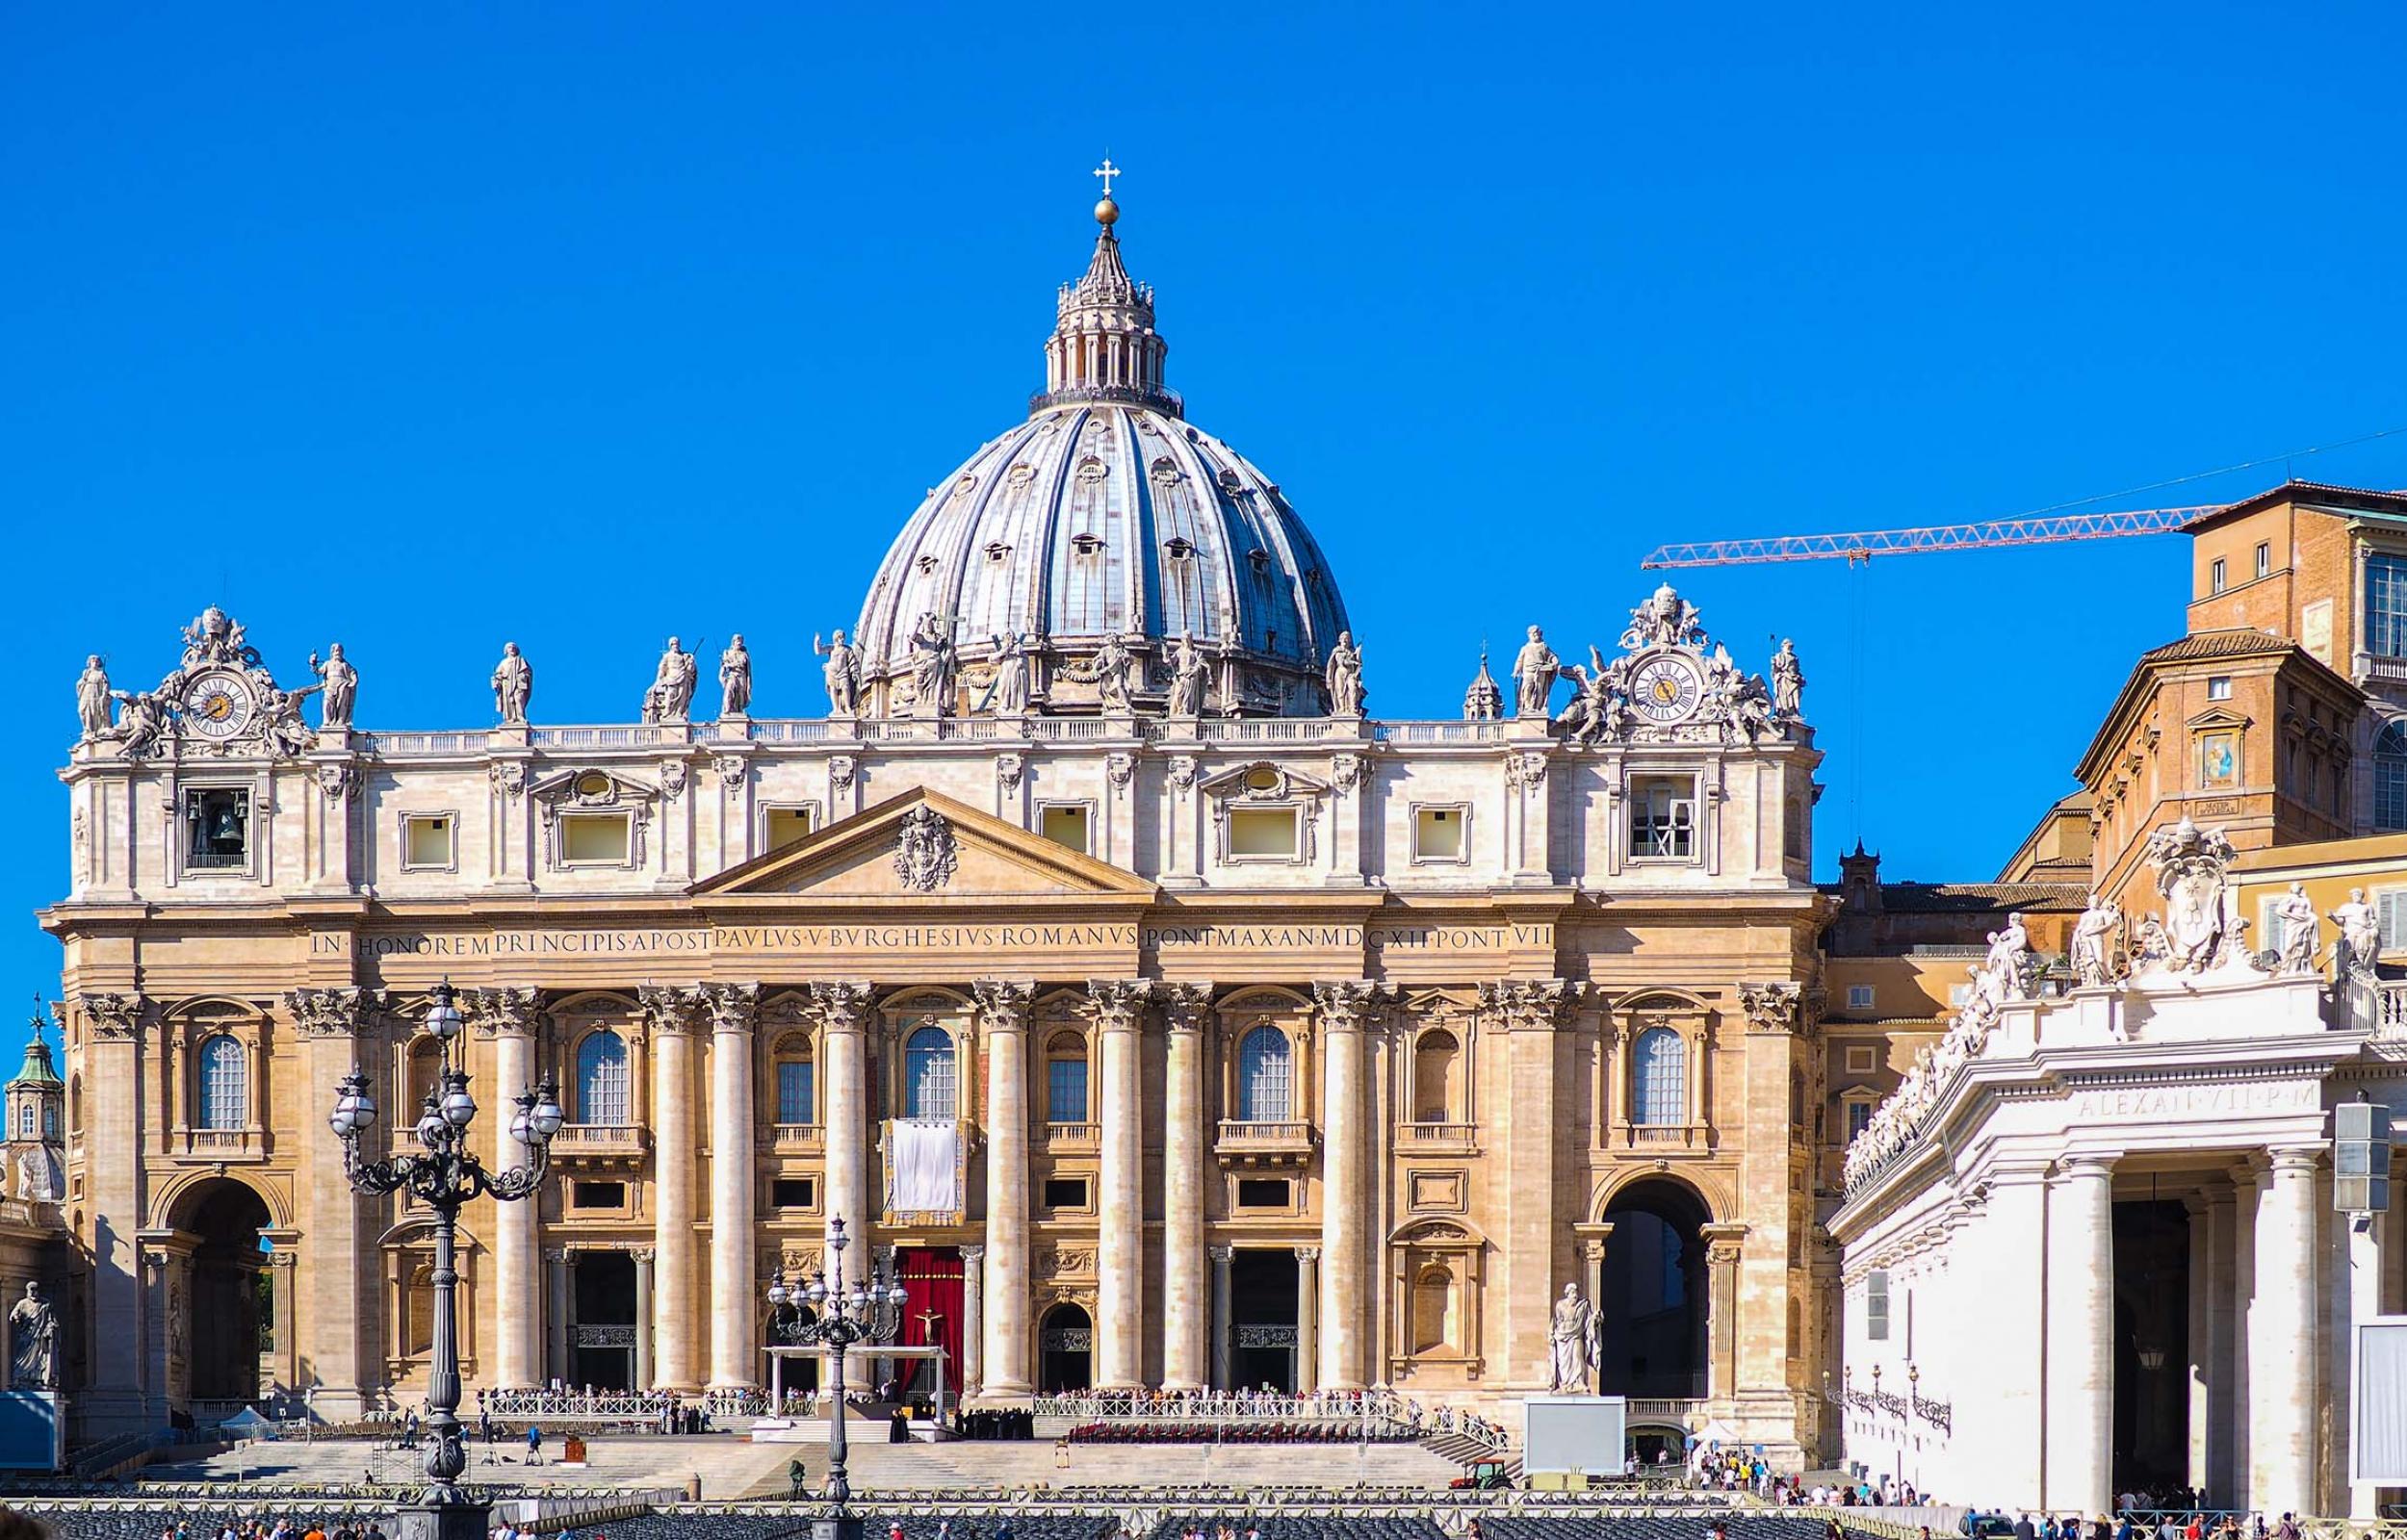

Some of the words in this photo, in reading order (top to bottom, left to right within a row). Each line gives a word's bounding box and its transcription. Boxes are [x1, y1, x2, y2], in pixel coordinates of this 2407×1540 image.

[312, 936, 340, 953] IN
[357, 937, 490, 956] HONOREM
[494, 933, 626, 952] PRINCIPIS
[632, 931, 712, 950] APOST
[713, 928, 802, 948] PAVLVS
[808, 928, 822, 947] V
[830, 927, 994, 948] BVRGHESIVS
[1001, 926, 1137, 946] ROMANVS
[1146, 928, 1213, 947] PONT
[1217, 928, 1273, 946] MAX
[1279, 928, 1313, 946] AN
[1436, 930, 1506, 949] PONT
[1514, 926, 1550, 945] VII
